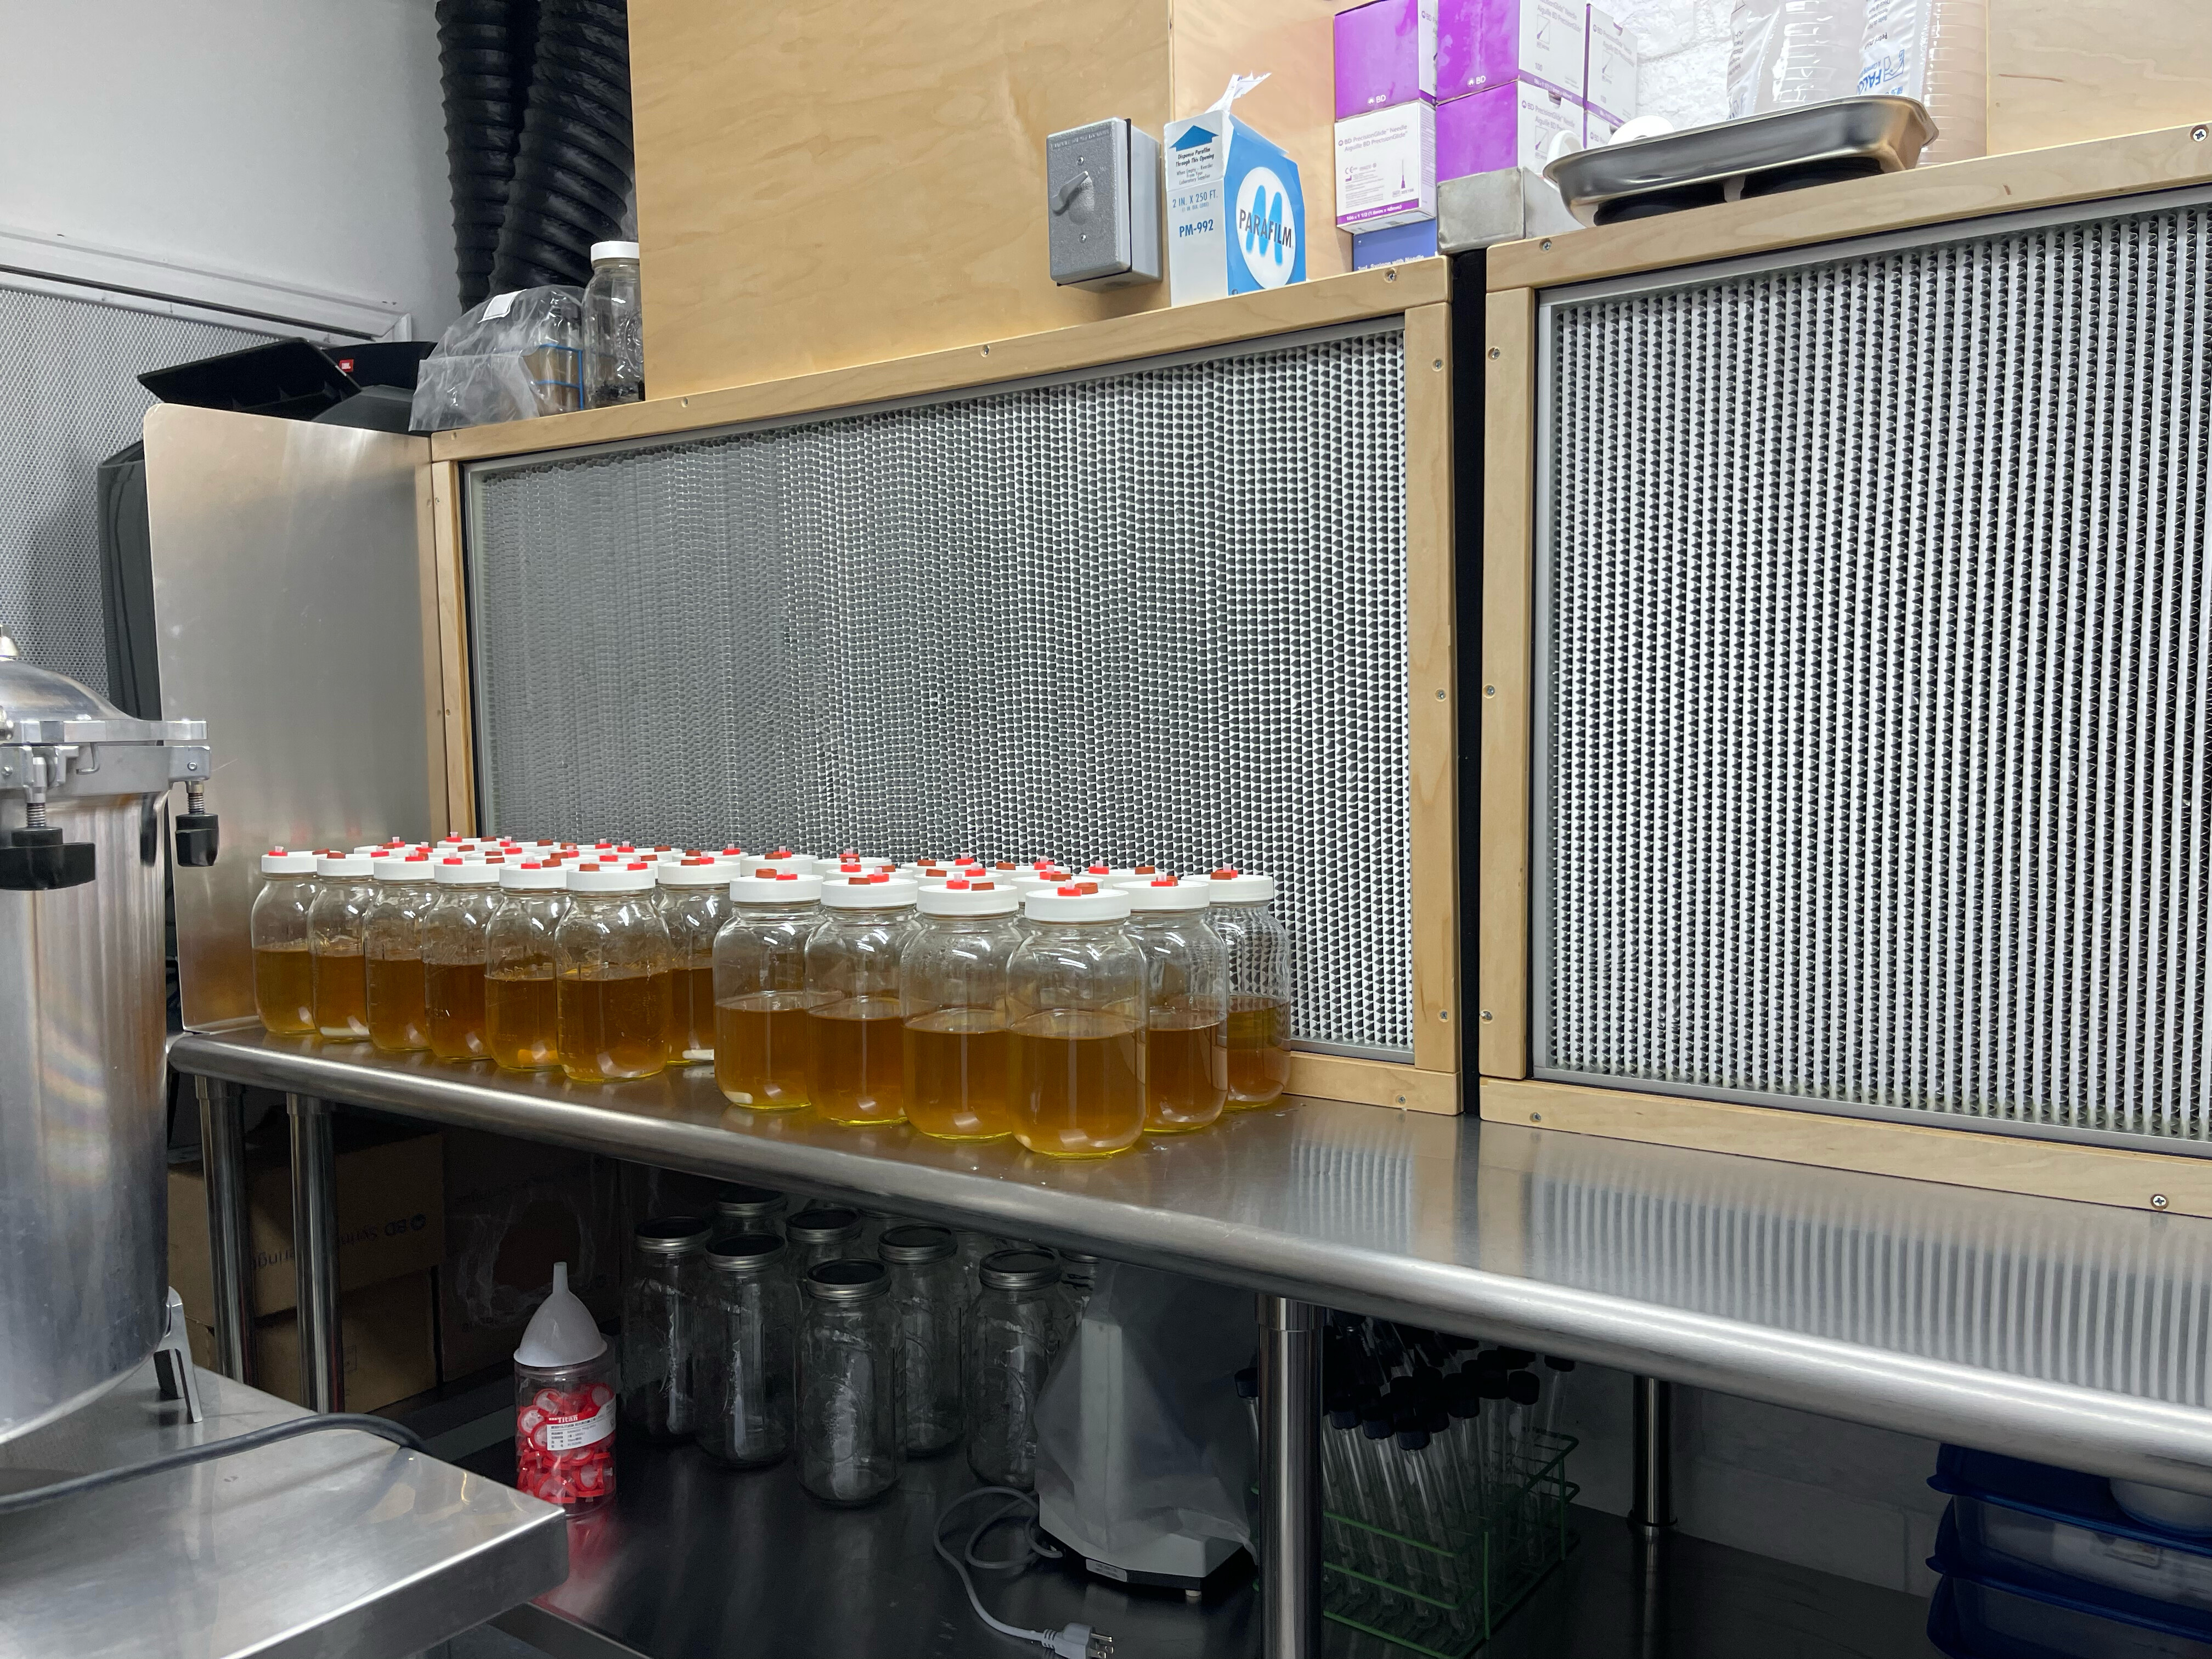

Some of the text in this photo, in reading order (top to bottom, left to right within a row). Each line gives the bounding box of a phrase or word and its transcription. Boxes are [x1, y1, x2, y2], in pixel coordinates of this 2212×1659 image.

[1476, 76, 1486, 84] BD
[1376, 94, 1386, 103] BD
[1345, 143, 1362, 152] Aiguille
[1200, 154, 1214, 162] Opening
[1172, 199, 1176, 208] 2
[1179, 196, 1187, 206] IN.
[1195, 191, 1207, 202] 250
[1210, 189, 1218, 199] FT.
[1179, 219, 1214, 238] PM-992
[557, 1414, 578, 1423] Titan
